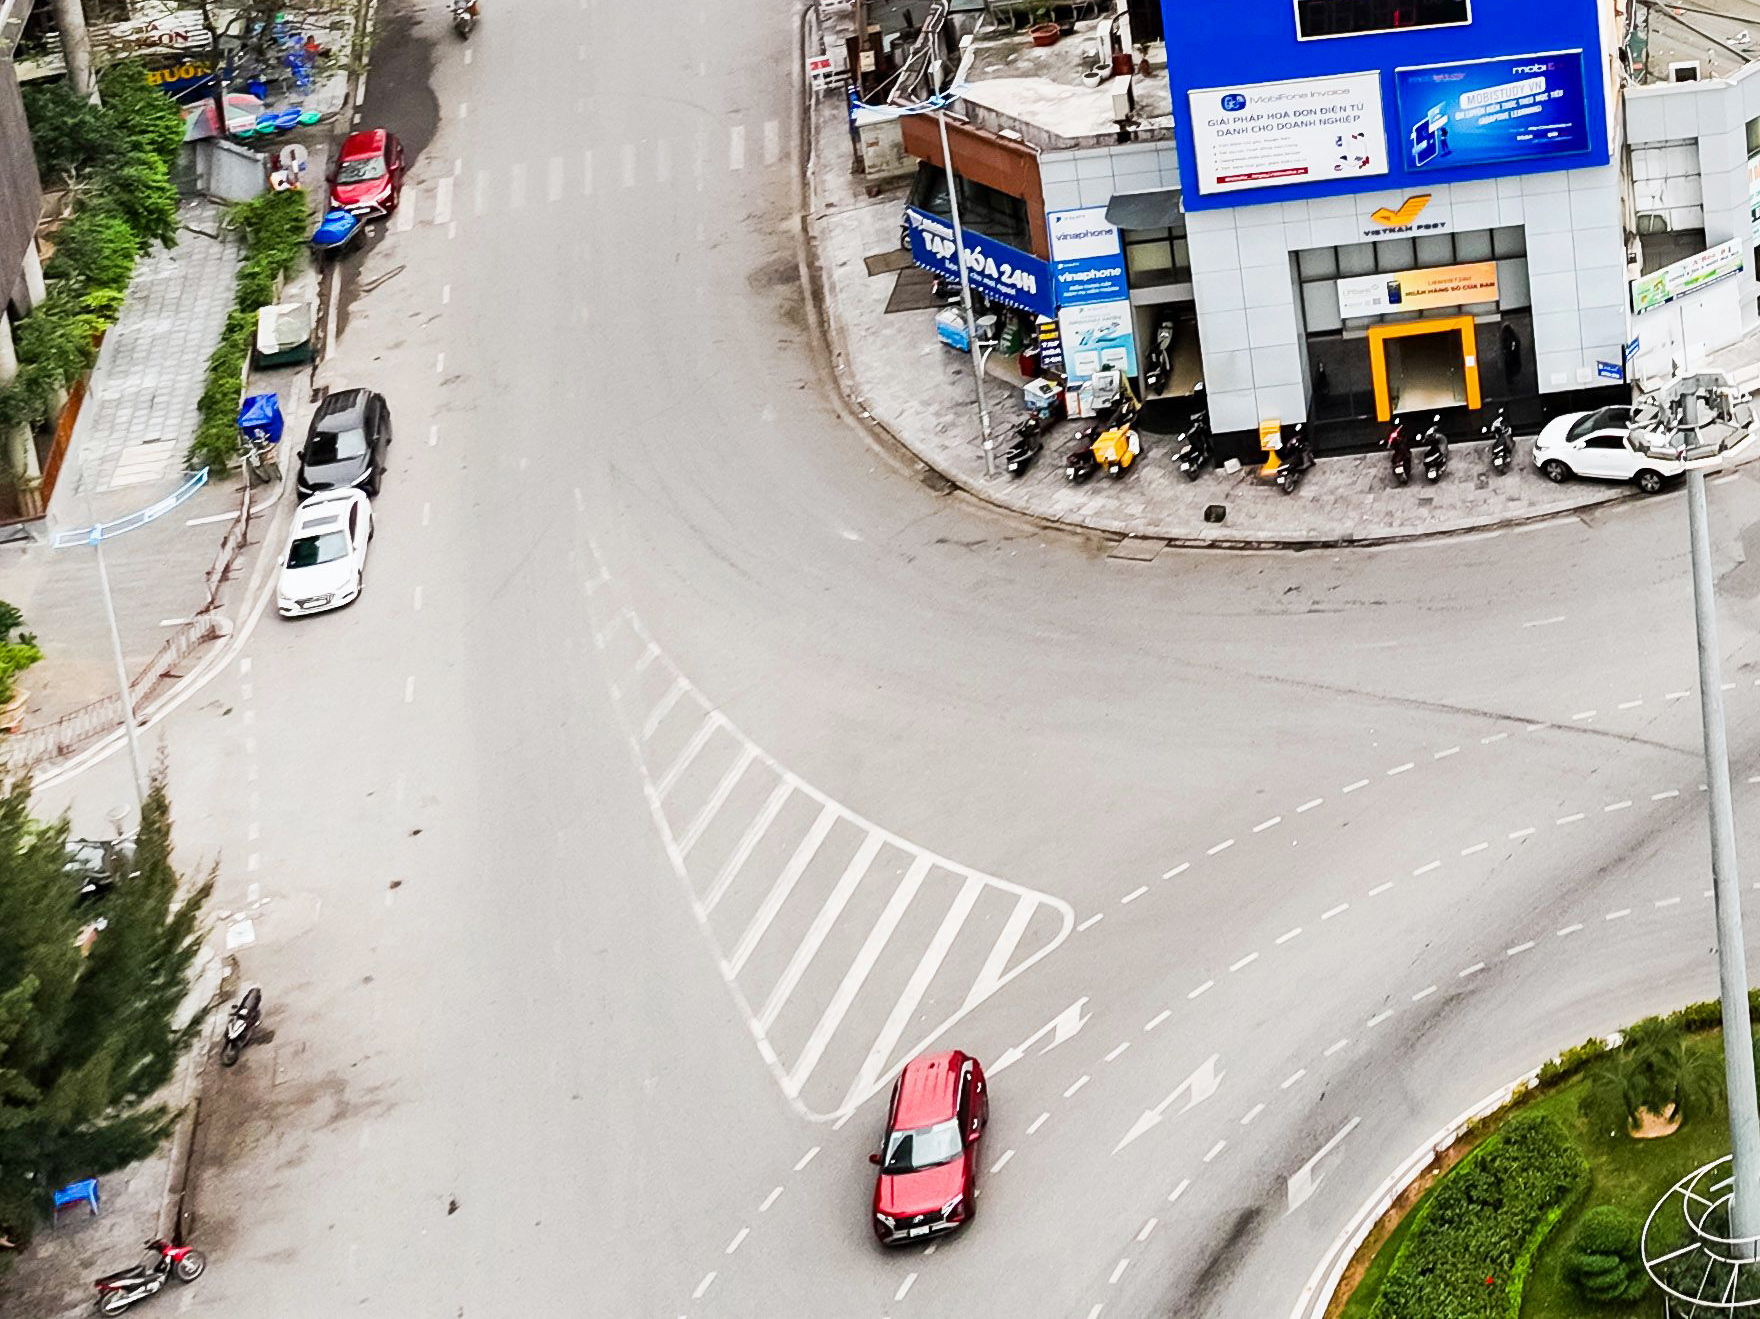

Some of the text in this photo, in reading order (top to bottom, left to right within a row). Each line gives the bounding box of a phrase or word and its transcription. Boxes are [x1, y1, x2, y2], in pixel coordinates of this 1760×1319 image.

[1310, 88, 1350, 98] Invoice
[1251, 123, 1275, 133] CHO
[1277, 119, 1316, 131] DOANH
[1055, 227, 1113, 241] vinaphone
[1363, 222, 1446, 236] VIETNAM POST
[922, 231, 956, 259] TẠP
[1000, 263, 1037, 295] 24H
[1058, 267, 1121, 282] vinaphone
